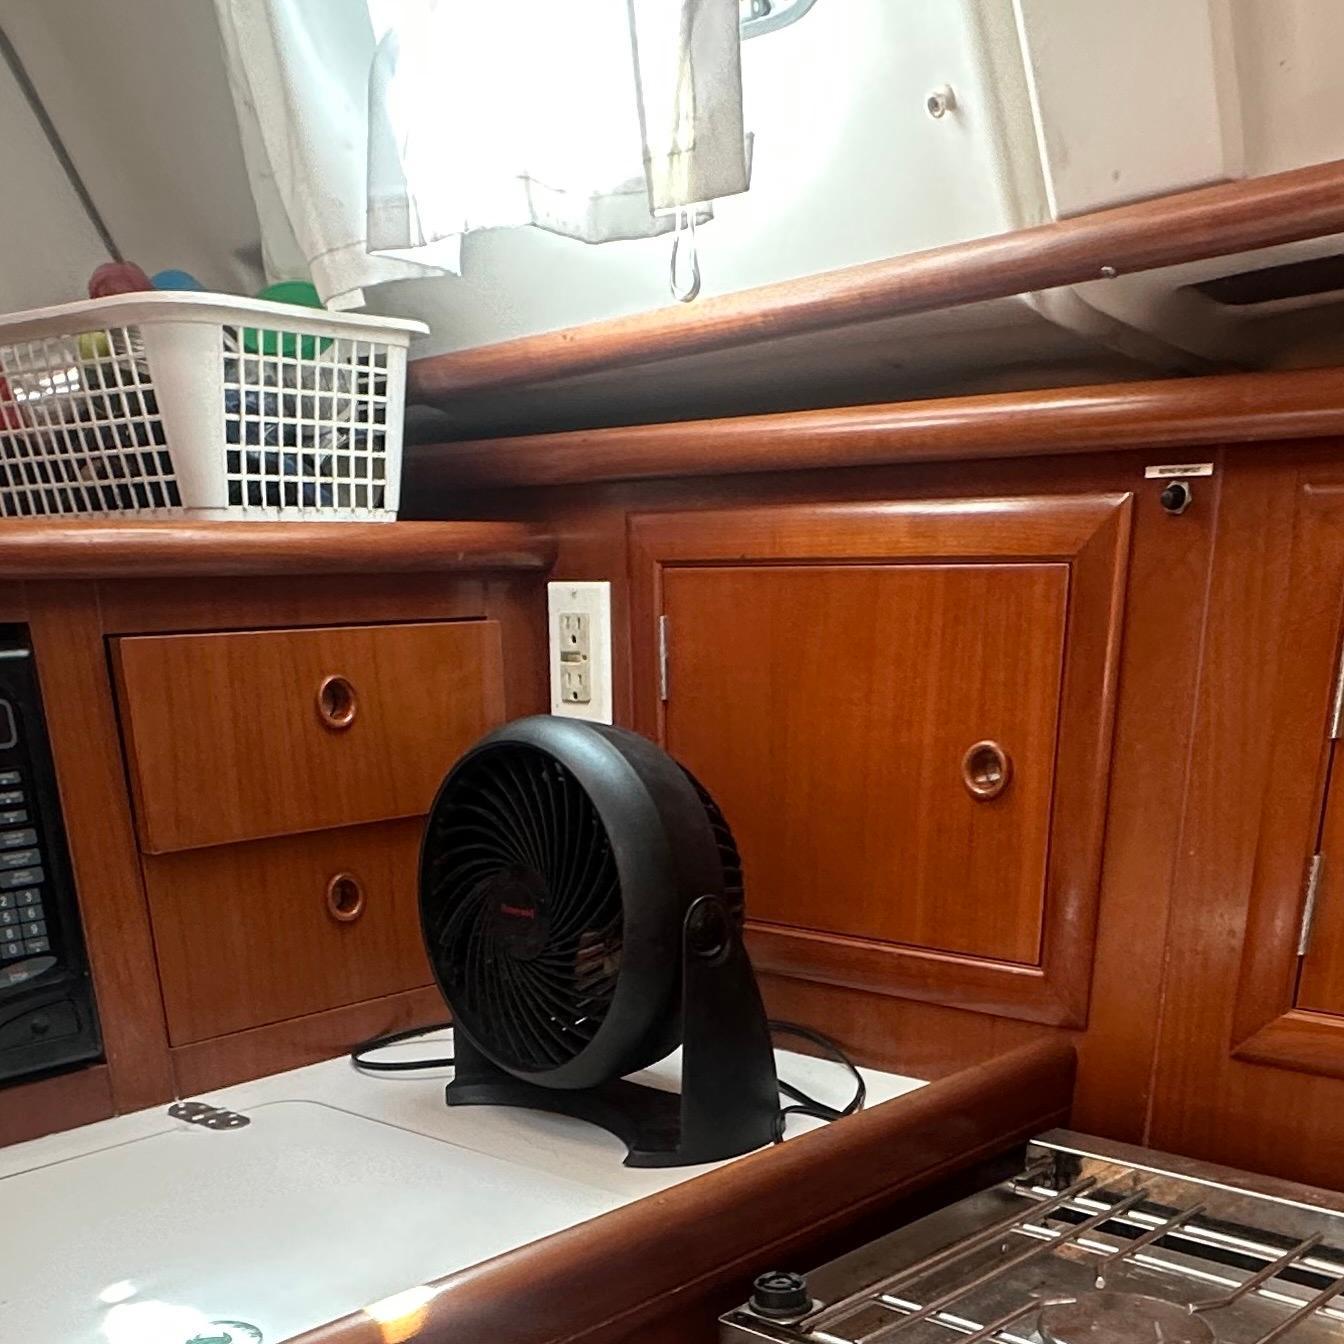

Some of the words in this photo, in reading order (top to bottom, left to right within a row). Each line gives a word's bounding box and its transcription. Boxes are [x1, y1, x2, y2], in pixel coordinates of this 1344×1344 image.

[0, 895, 8, 907] 2
[24, 891, 33, 903] 3
[2, 912, 11, 923] 5
[27, 908, 35, 919] 6
[5, 928, 14, 940] 8
[30, 923, 38, 935] 9
[8, 943, 17, 954] 0
